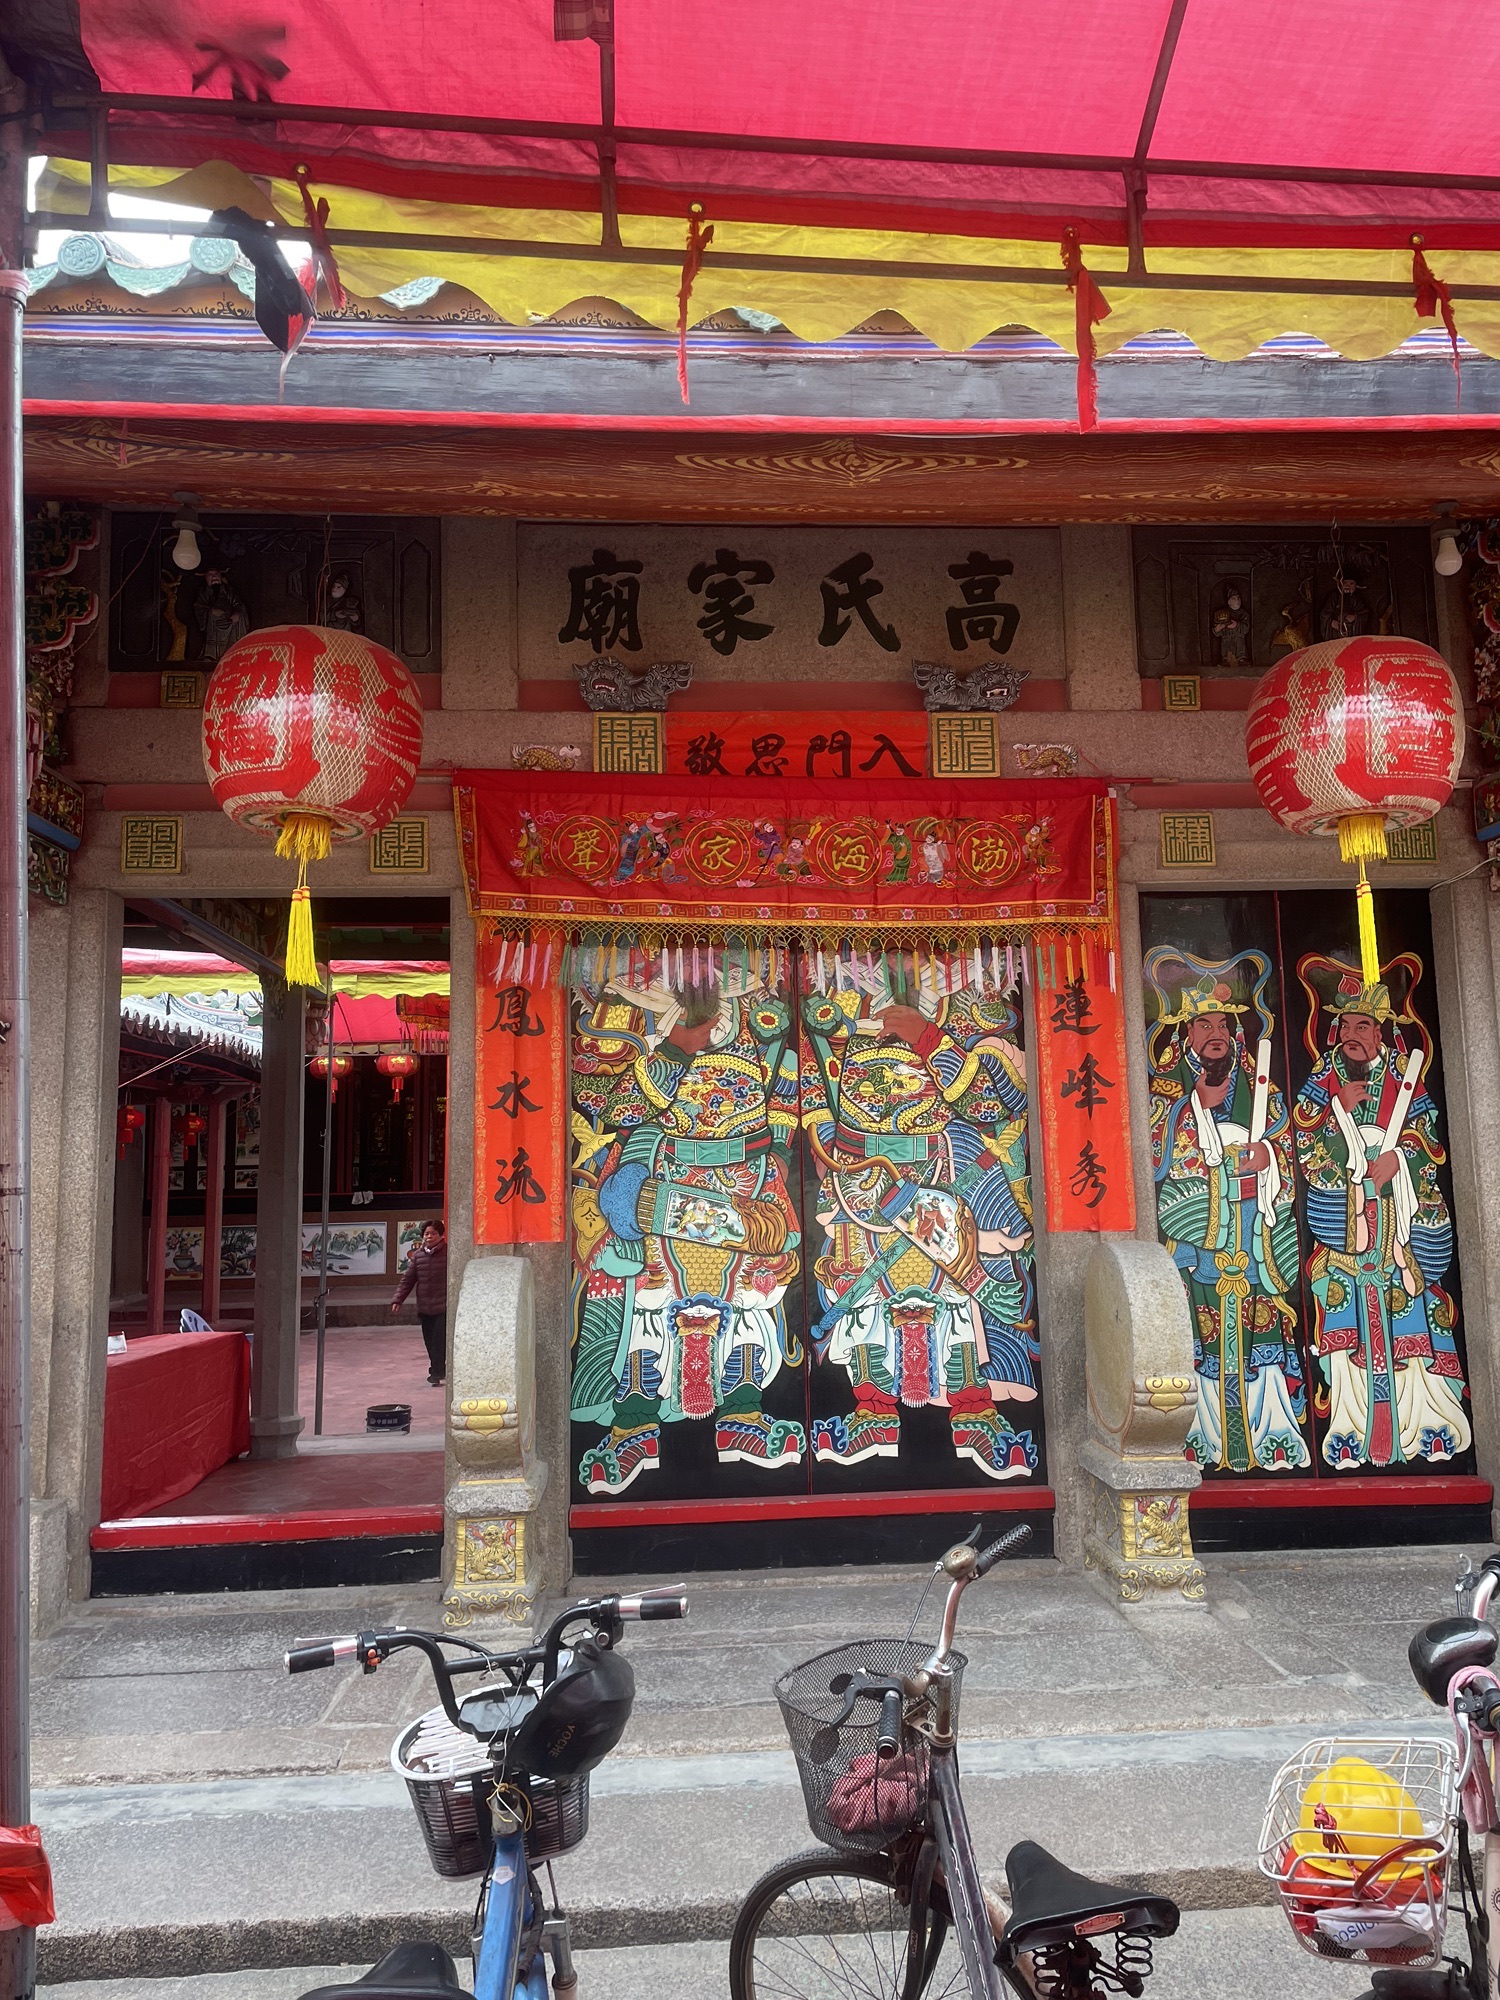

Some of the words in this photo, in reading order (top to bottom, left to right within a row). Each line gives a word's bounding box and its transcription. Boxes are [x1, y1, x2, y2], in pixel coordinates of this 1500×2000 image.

[558, 548, 1021, 655] 高氏家廟
[684, 729, 923, 778] 入門思敬
[567, 827, 1009, 873] 渤海家聲
[1049, 921, 1116, 1209] 蓮峰秀
[580, 1206, 600, 1228] 令
